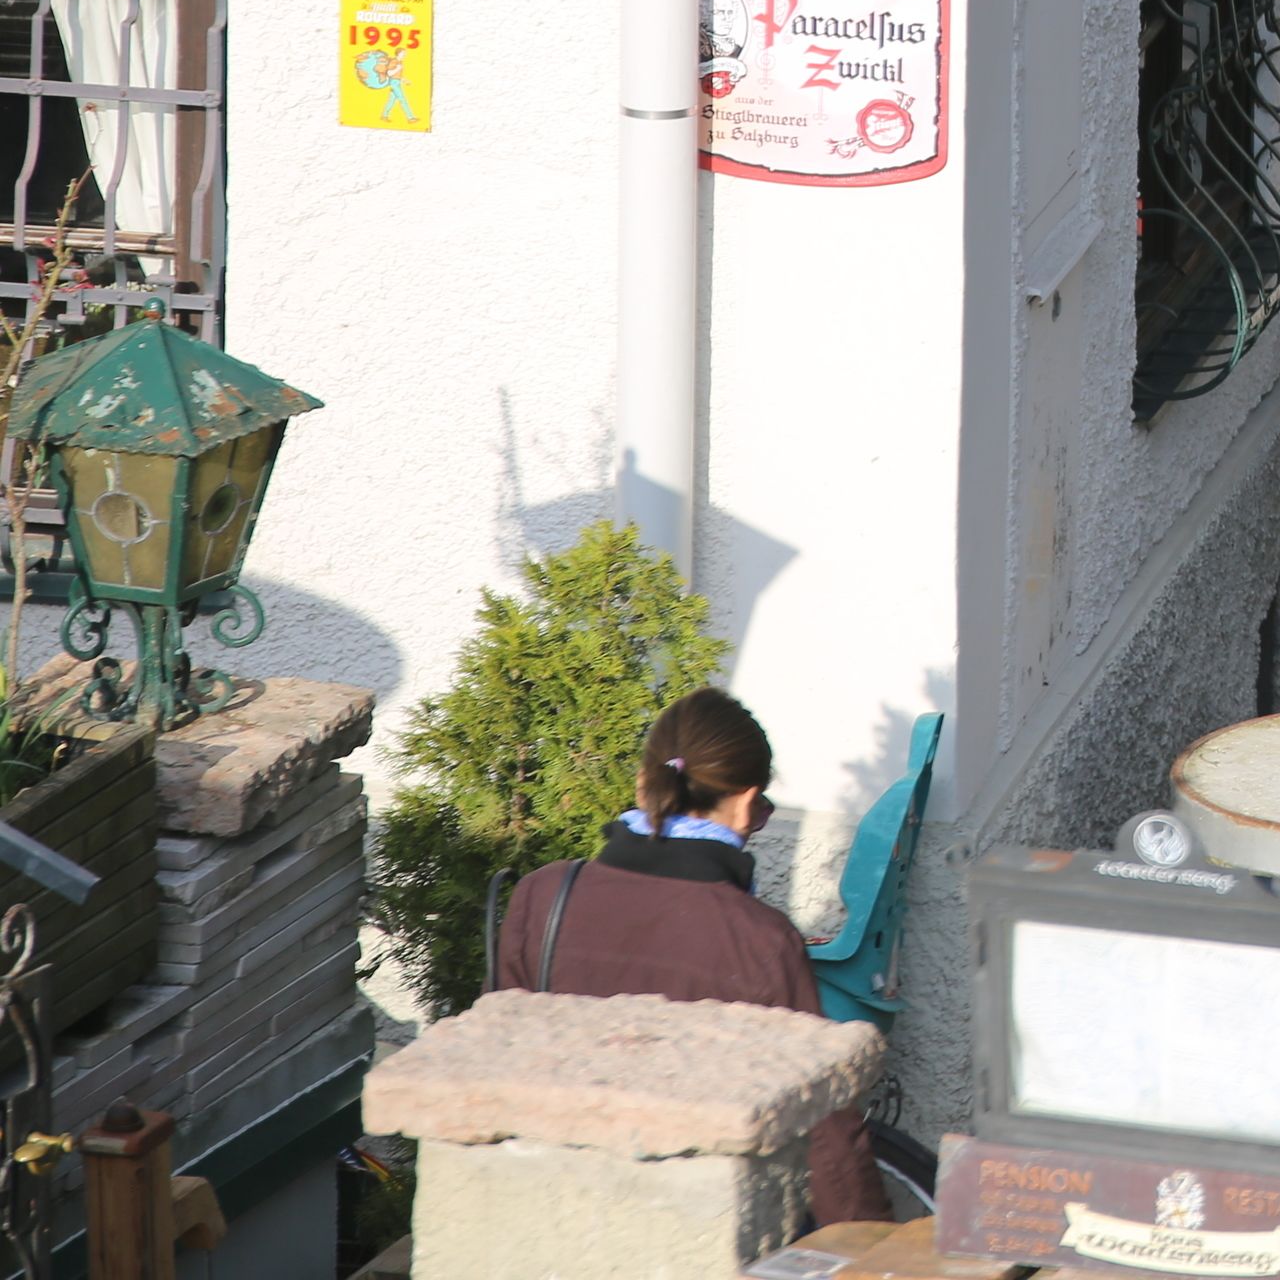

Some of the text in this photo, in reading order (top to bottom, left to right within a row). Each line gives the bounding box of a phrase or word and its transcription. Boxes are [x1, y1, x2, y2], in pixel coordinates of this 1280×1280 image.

[349, 25, 422, 50] 1995
[702, 104, 808, 127] Stieglbrauerei
[731, 127, 800, 148] Salzburg
[979, 1159, 1094, 1195] PENSION
